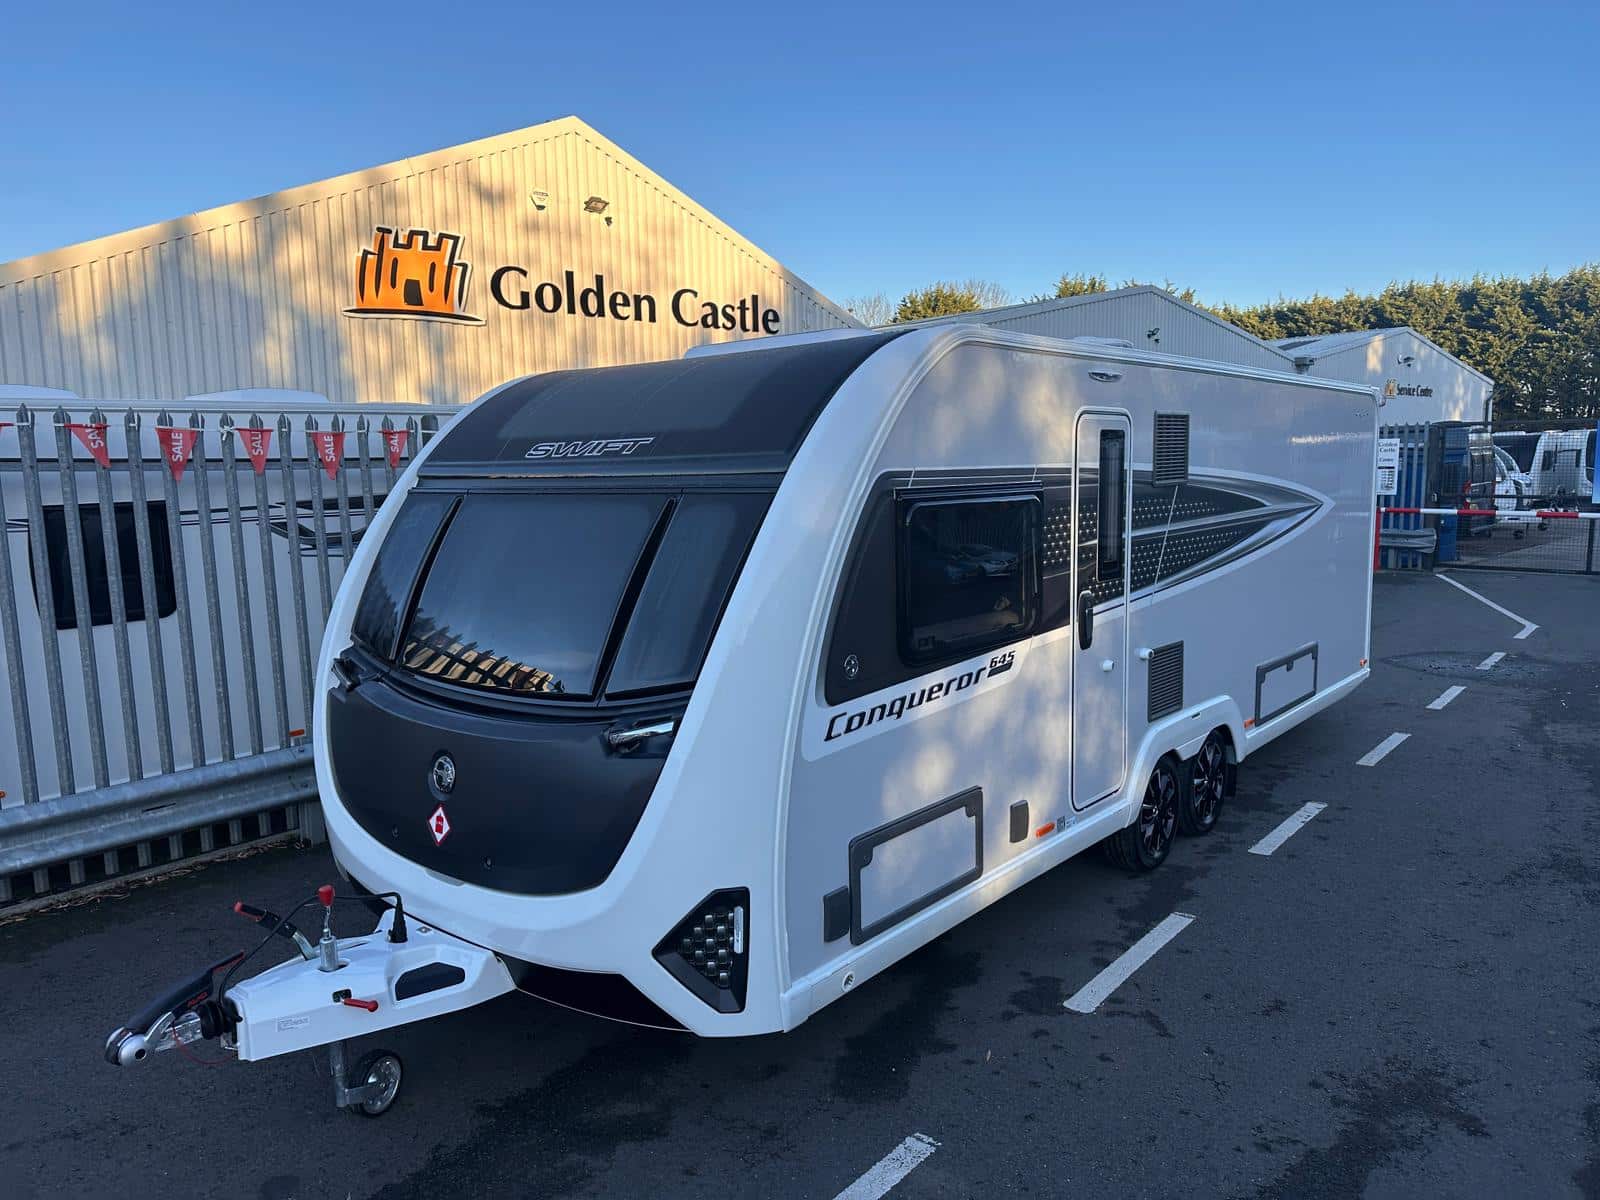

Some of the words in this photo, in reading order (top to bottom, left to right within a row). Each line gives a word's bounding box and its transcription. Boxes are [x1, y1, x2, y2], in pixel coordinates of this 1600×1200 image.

[490, 265, 656, 323] Golden
[671, 288, 780, 335] Castle
[171, 432, 183, 462] SALE
[323, 435, 335, 462] SALE
[525, 436, 656, 459] SWIFT
[824, 665, 987, 742] Conqueror
[989, 650, 1016, 669] 645
